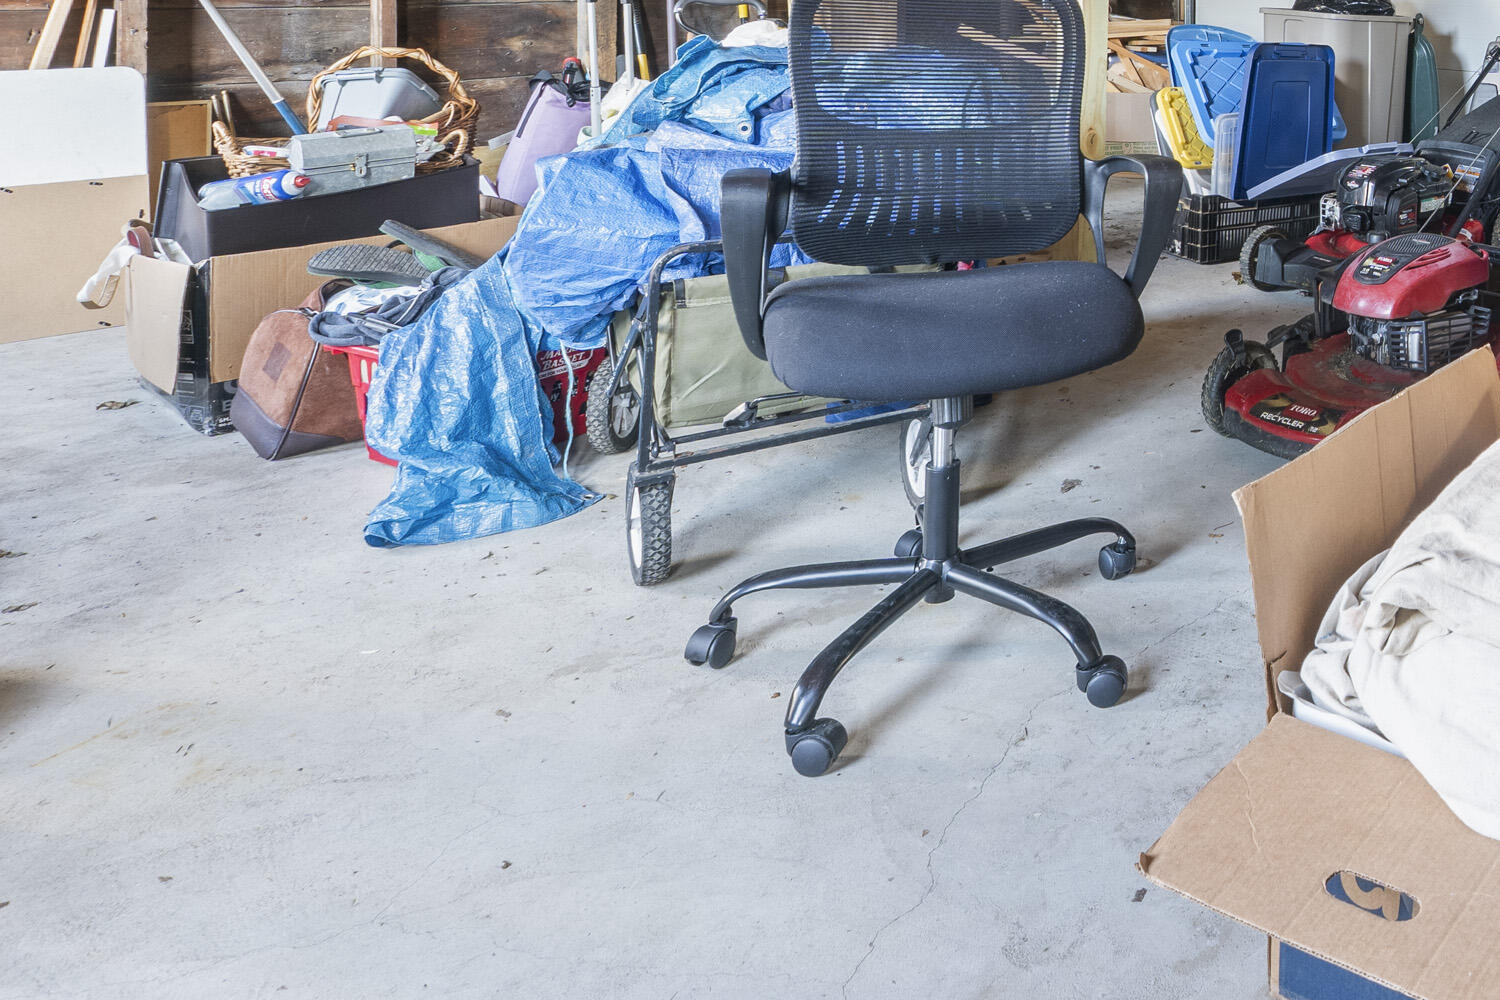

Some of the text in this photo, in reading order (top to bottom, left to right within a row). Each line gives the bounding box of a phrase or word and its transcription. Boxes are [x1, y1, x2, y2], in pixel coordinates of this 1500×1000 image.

[541, 351, 586, 371] BASET
[1289, 403, 1318, 417] TORO
[1260, 411, 1305, 429] RECYCLER
